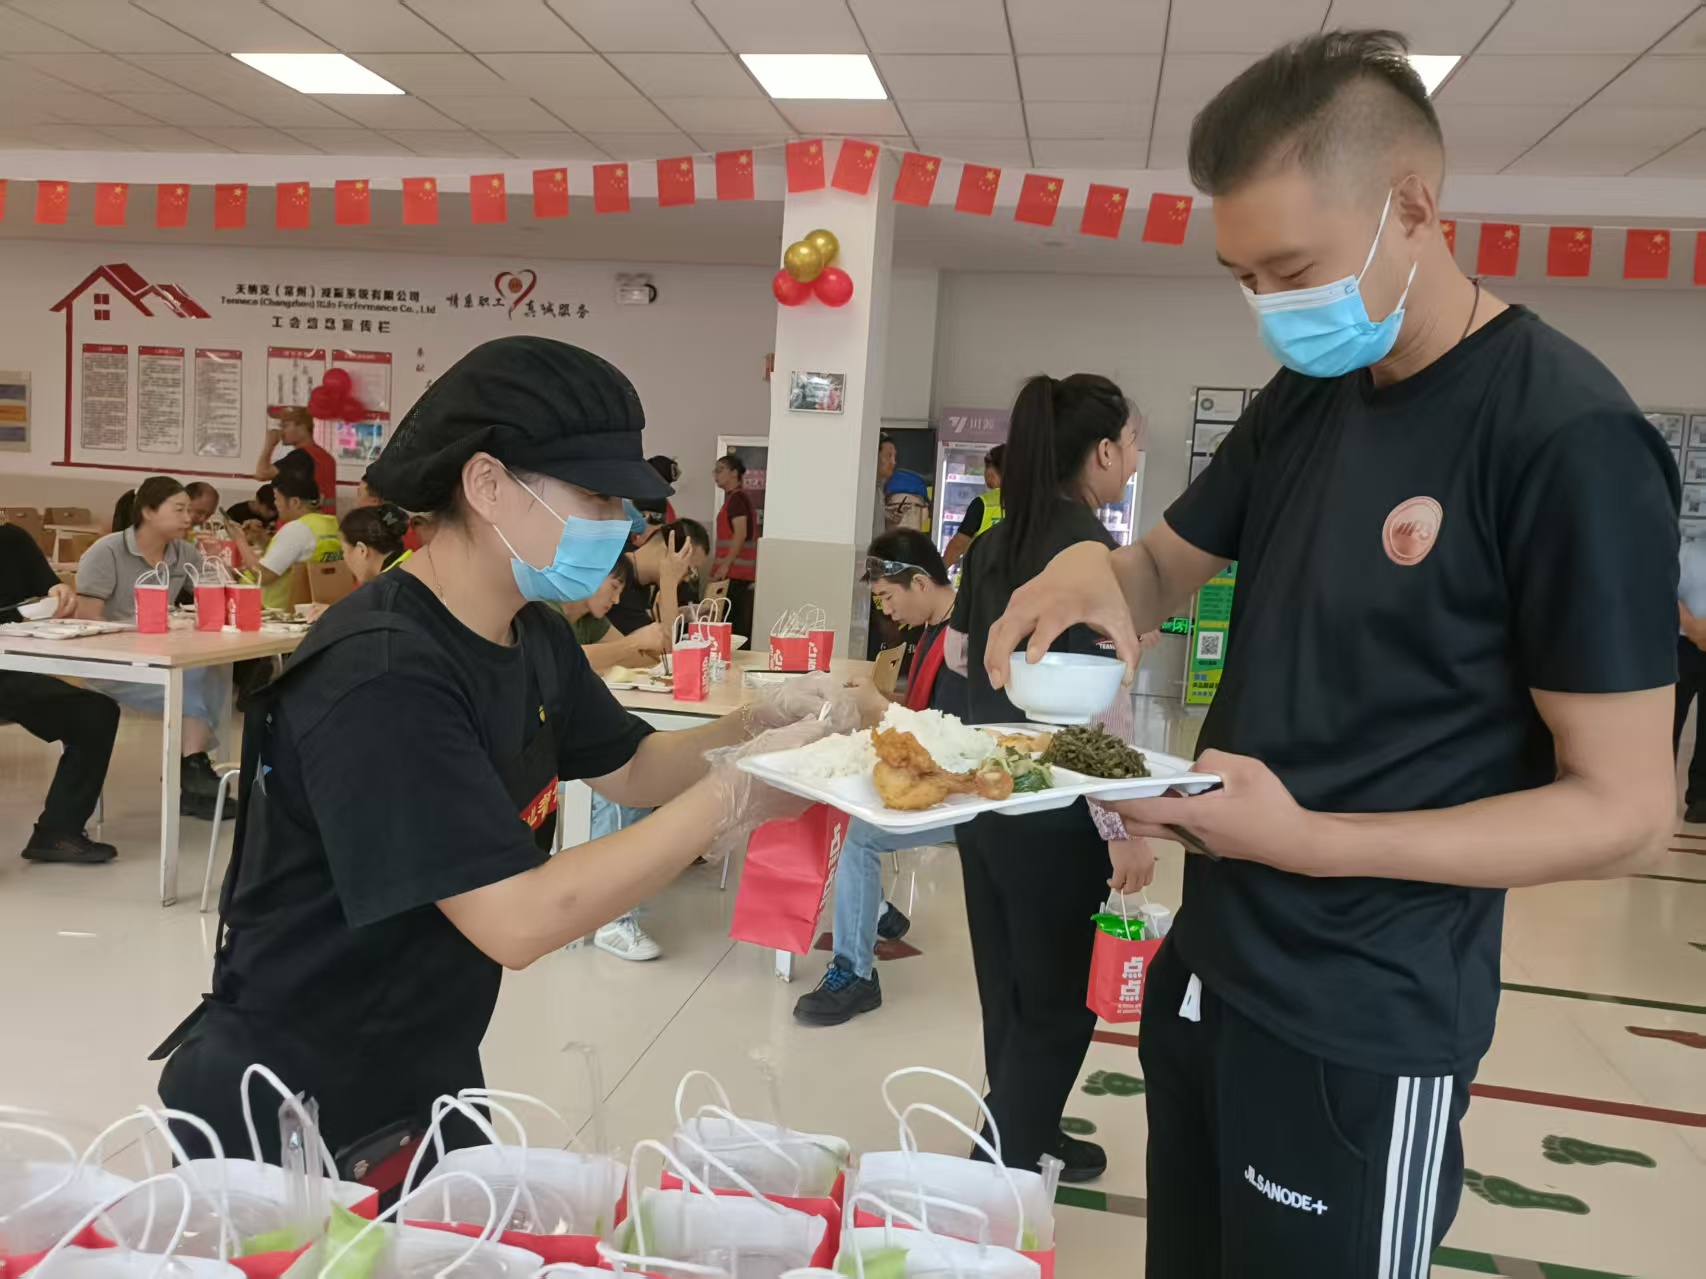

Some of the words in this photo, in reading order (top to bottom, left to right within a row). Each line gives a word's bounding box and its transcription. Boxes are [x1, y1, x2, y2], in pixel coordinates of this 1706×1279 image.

[272, 316, 391, 334] 工会信息宣传栏
